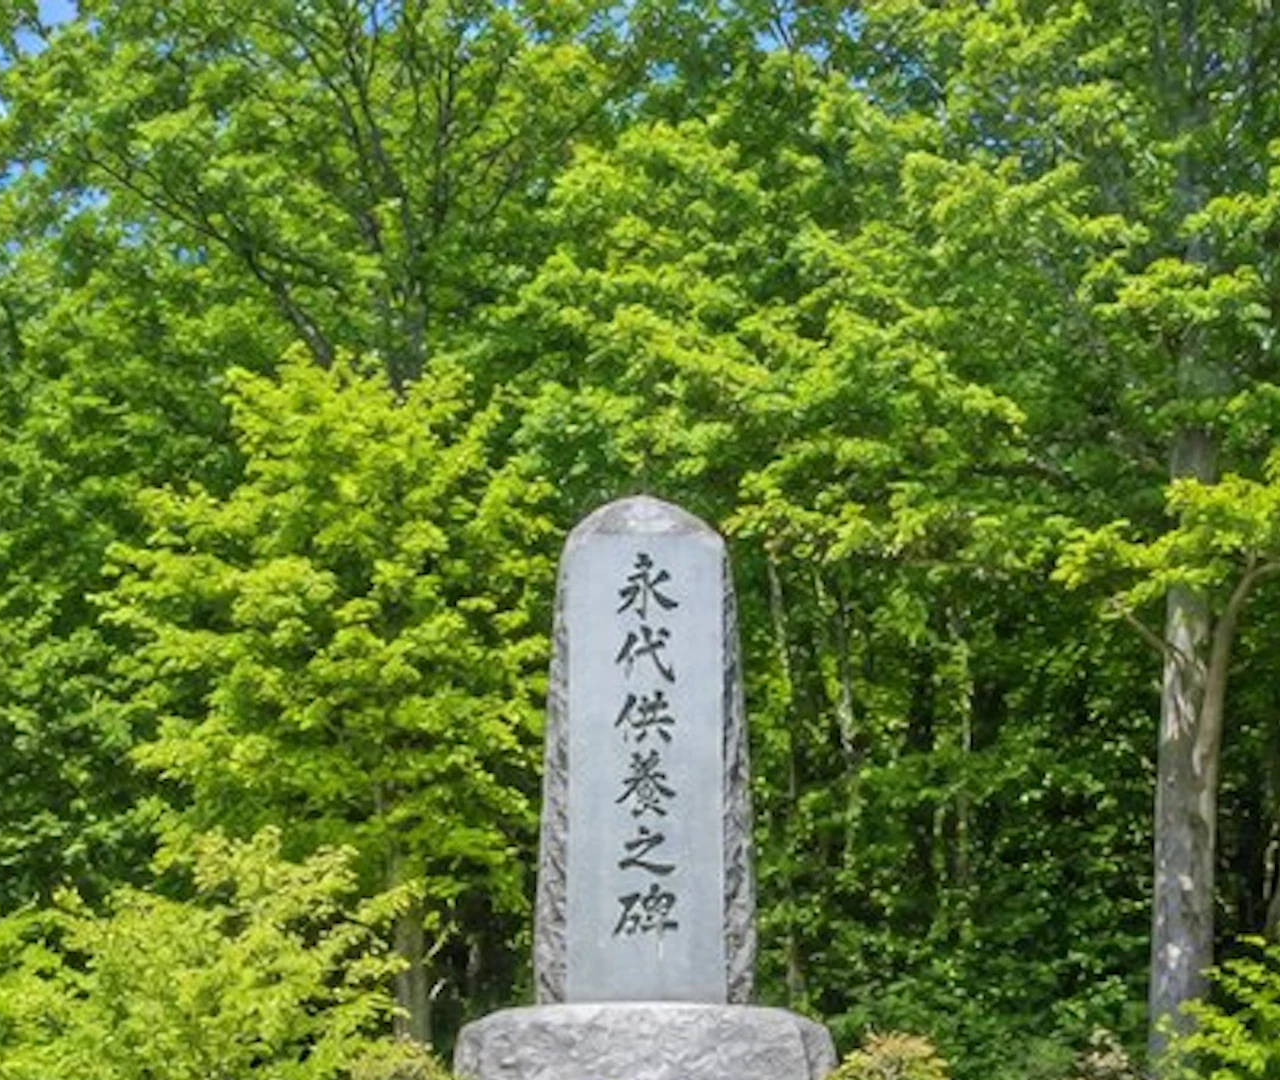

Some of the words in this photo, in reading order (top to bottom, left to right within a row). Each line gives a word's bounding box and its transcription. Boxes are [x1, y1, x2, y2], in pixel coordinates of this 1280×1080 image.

[613, 552, 680, 938] 永代供養之碑
